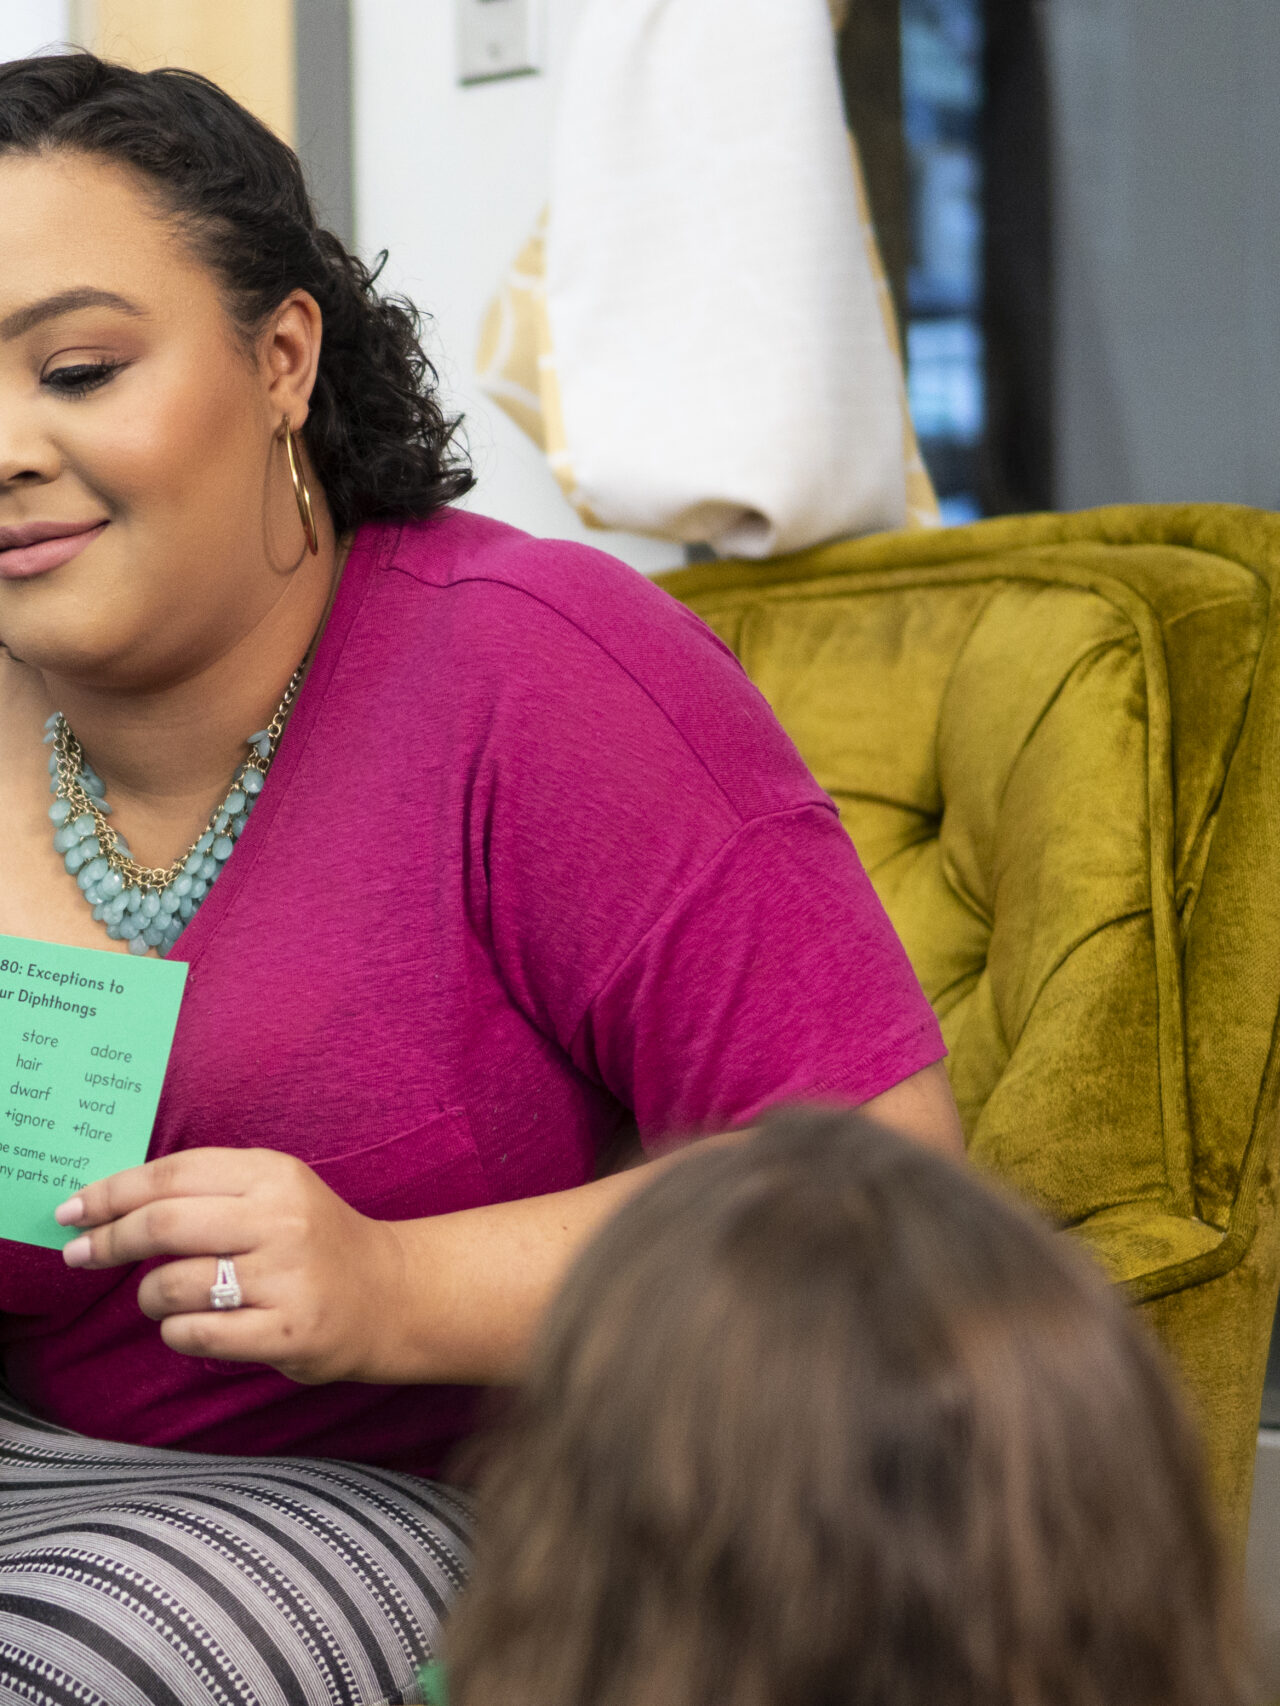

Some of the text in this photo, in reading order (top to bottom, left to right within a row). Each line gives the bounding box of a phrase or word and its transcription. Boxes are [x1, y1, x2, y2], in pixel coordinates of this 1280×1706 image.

[0, 959, 23, 975] 80:
[27, 963, 105, 991] Exceptions
[110, 979, 124, 994] to
[18, 989, 97, 1019] Diphthongs
[22, 1030, 58, 1048] store
[90, 1045, 132, 1063] adore
[16, 1054, 42, 1071] hair
[84, 1072, 142, 1093] upstairs
[10, 1081, 52, 1100] dwarf
[79, 1098, 116, 1115] word
[5, 1108, 55, 1129] +ignore
[73, 1122, 112, 1142] +flare
[13, 1145, 45, 1161] same
[50, 1153, 90, 1170] word?
[16, 1168, 49, 1184] parts
[53, 1175, 68, 1187] of
